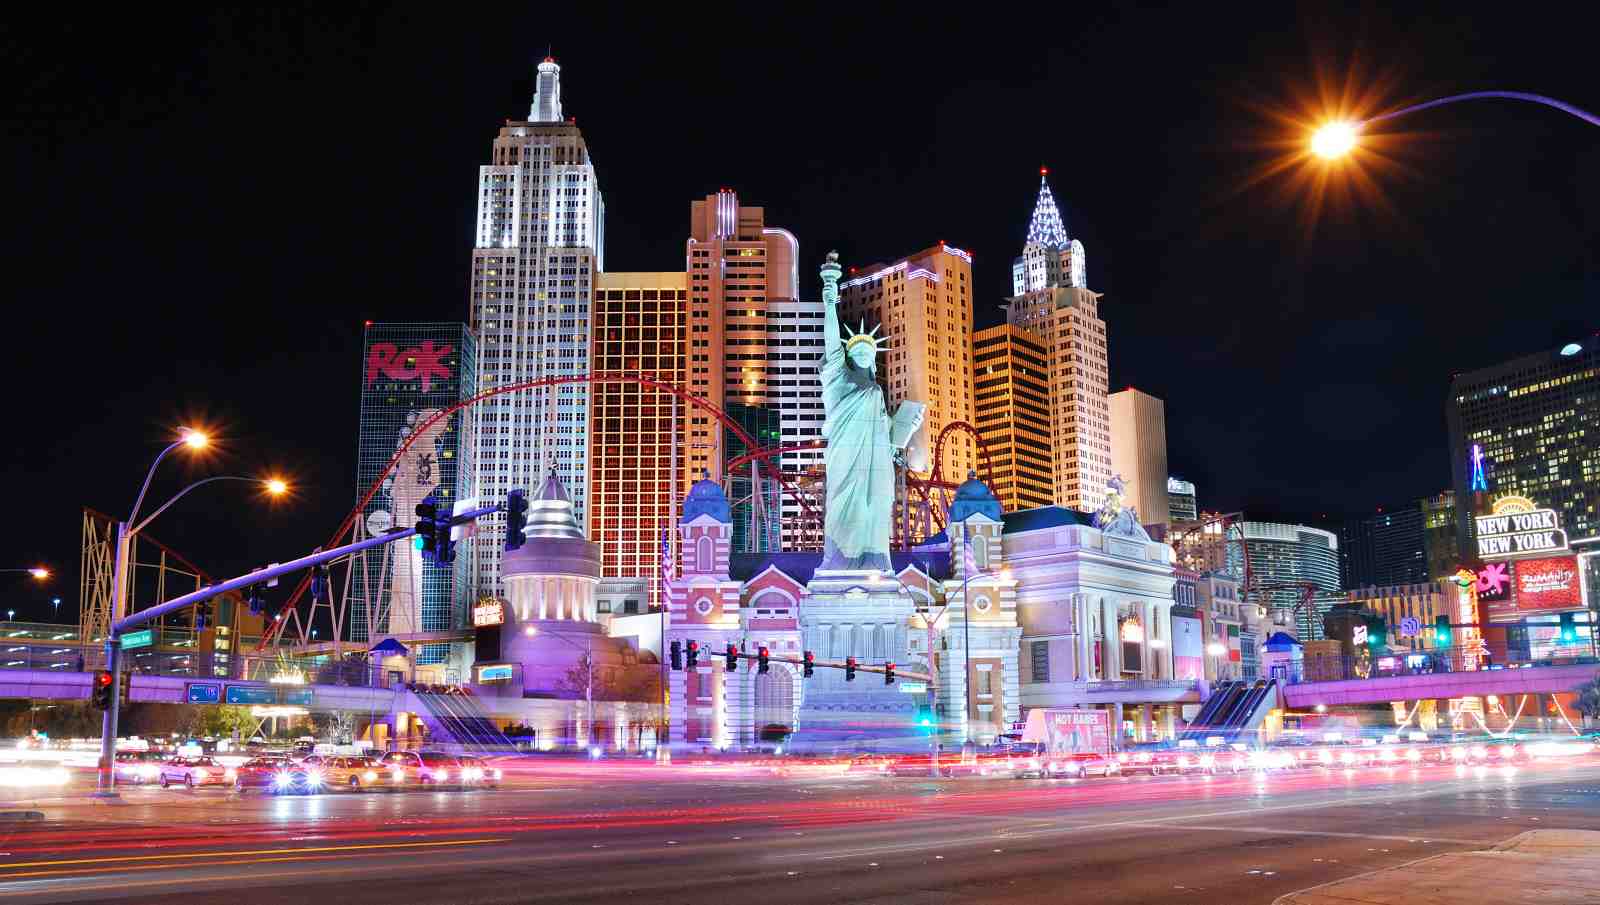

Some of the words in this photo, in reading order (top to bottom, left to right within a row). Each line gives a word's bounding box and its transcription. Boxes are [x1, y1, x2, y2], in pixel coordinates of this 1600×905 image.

[1476, 516, 1509, 535] NEW
[1511, 511, 1554, 531] YORK
[1478, 535, 1511, 555] NEW
[1513, 531, 1556, 551] YORK
